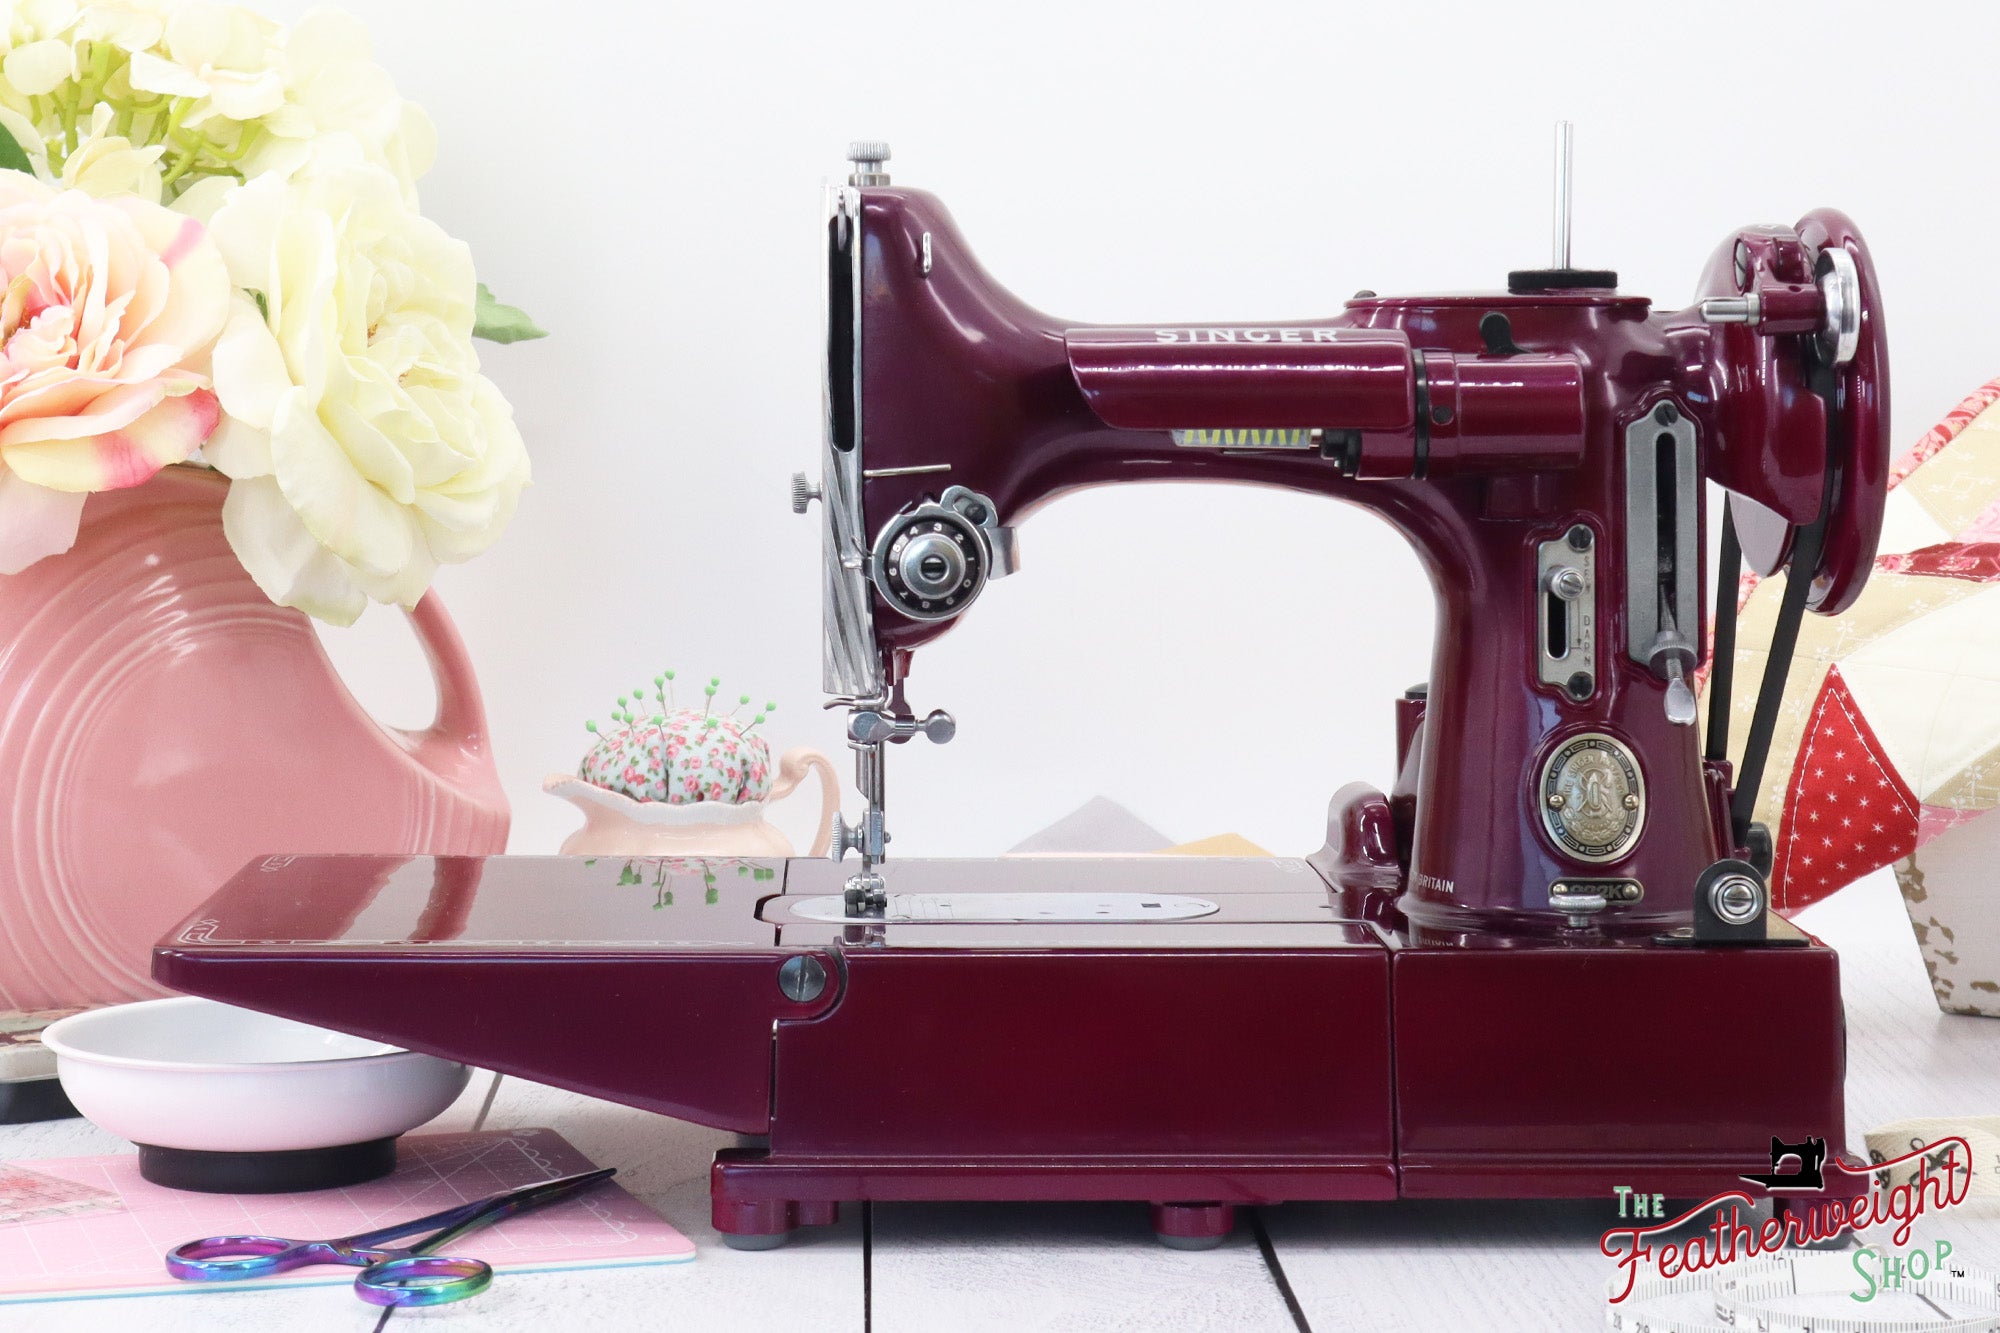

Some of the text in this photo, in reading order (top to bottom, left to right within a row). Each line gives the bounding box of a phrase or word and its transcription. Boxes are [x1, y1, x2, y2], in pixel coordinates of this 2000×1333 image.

[1154, 329, 1338, 343] SINGER
[909, 526, 919, 536] 4
[933, 522, 943, 532] 3
[954, 534, 964, 543] 2
[888, 567, 898, 577] 6
[899, 590, 909, 600] 7
[1418, 873, 1455, 894] BRITAIN
